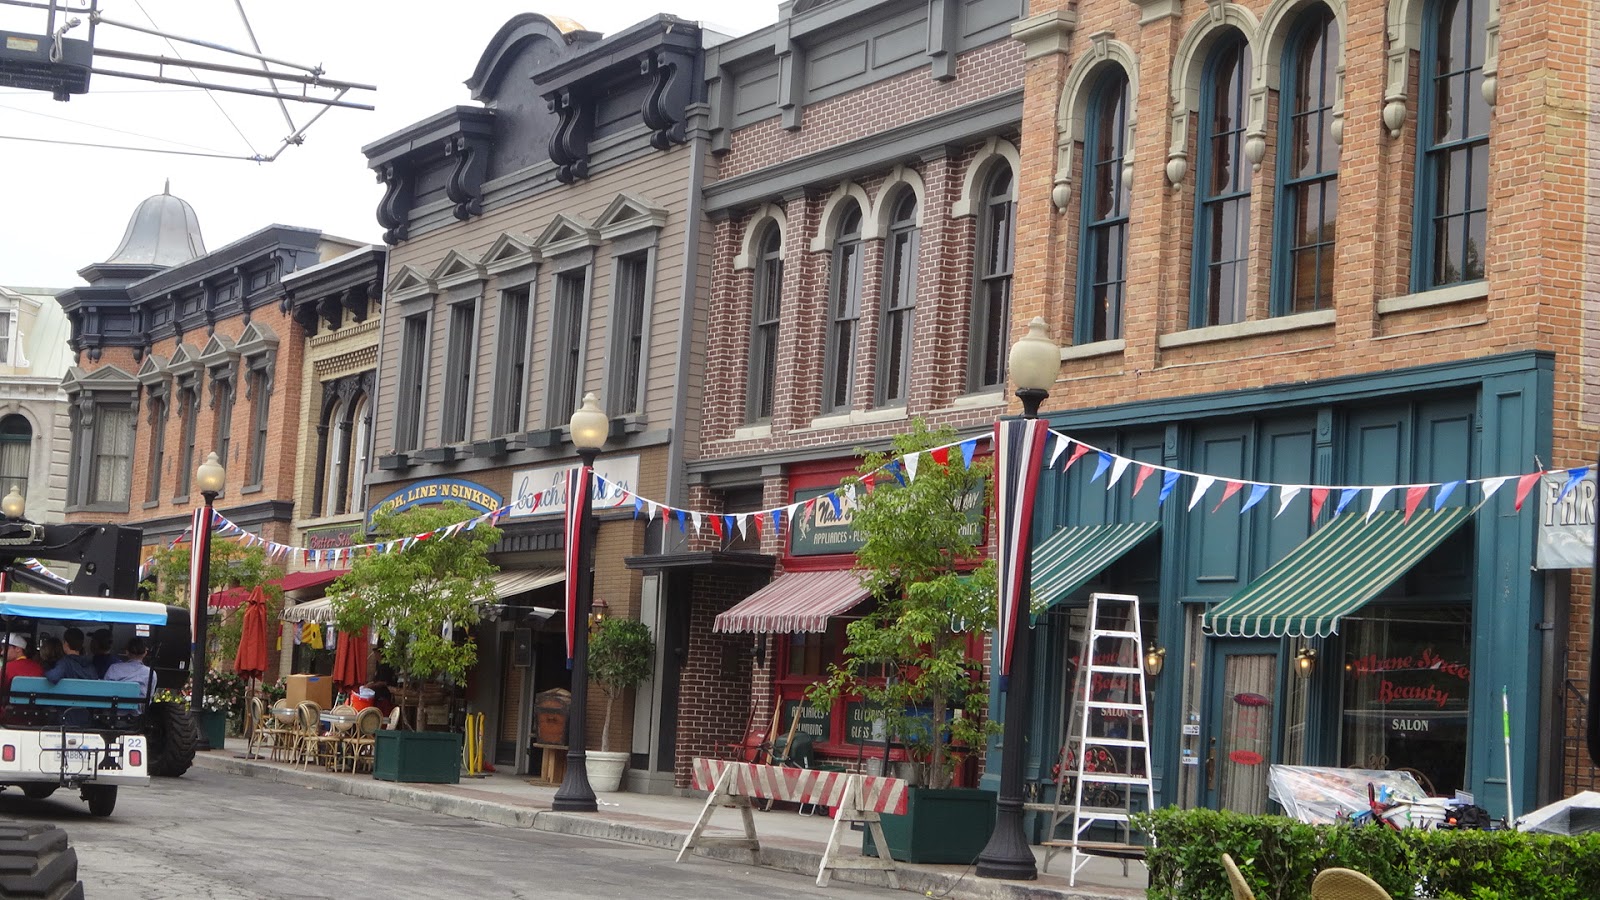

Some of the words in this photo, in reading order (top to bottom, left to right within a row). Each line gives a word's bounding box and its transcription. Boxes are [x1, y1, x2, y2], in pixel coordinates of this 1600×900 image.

[407, 485, 438, 502] LINE
[451, 484, 499, 511] SINKER
[813, 531, 848, 545] APPLIANCES
[1378, 680, 1449, 708] Beauty
[1392, 718, 1429, 731] SALON
[127, 738, 142, 748] 22
